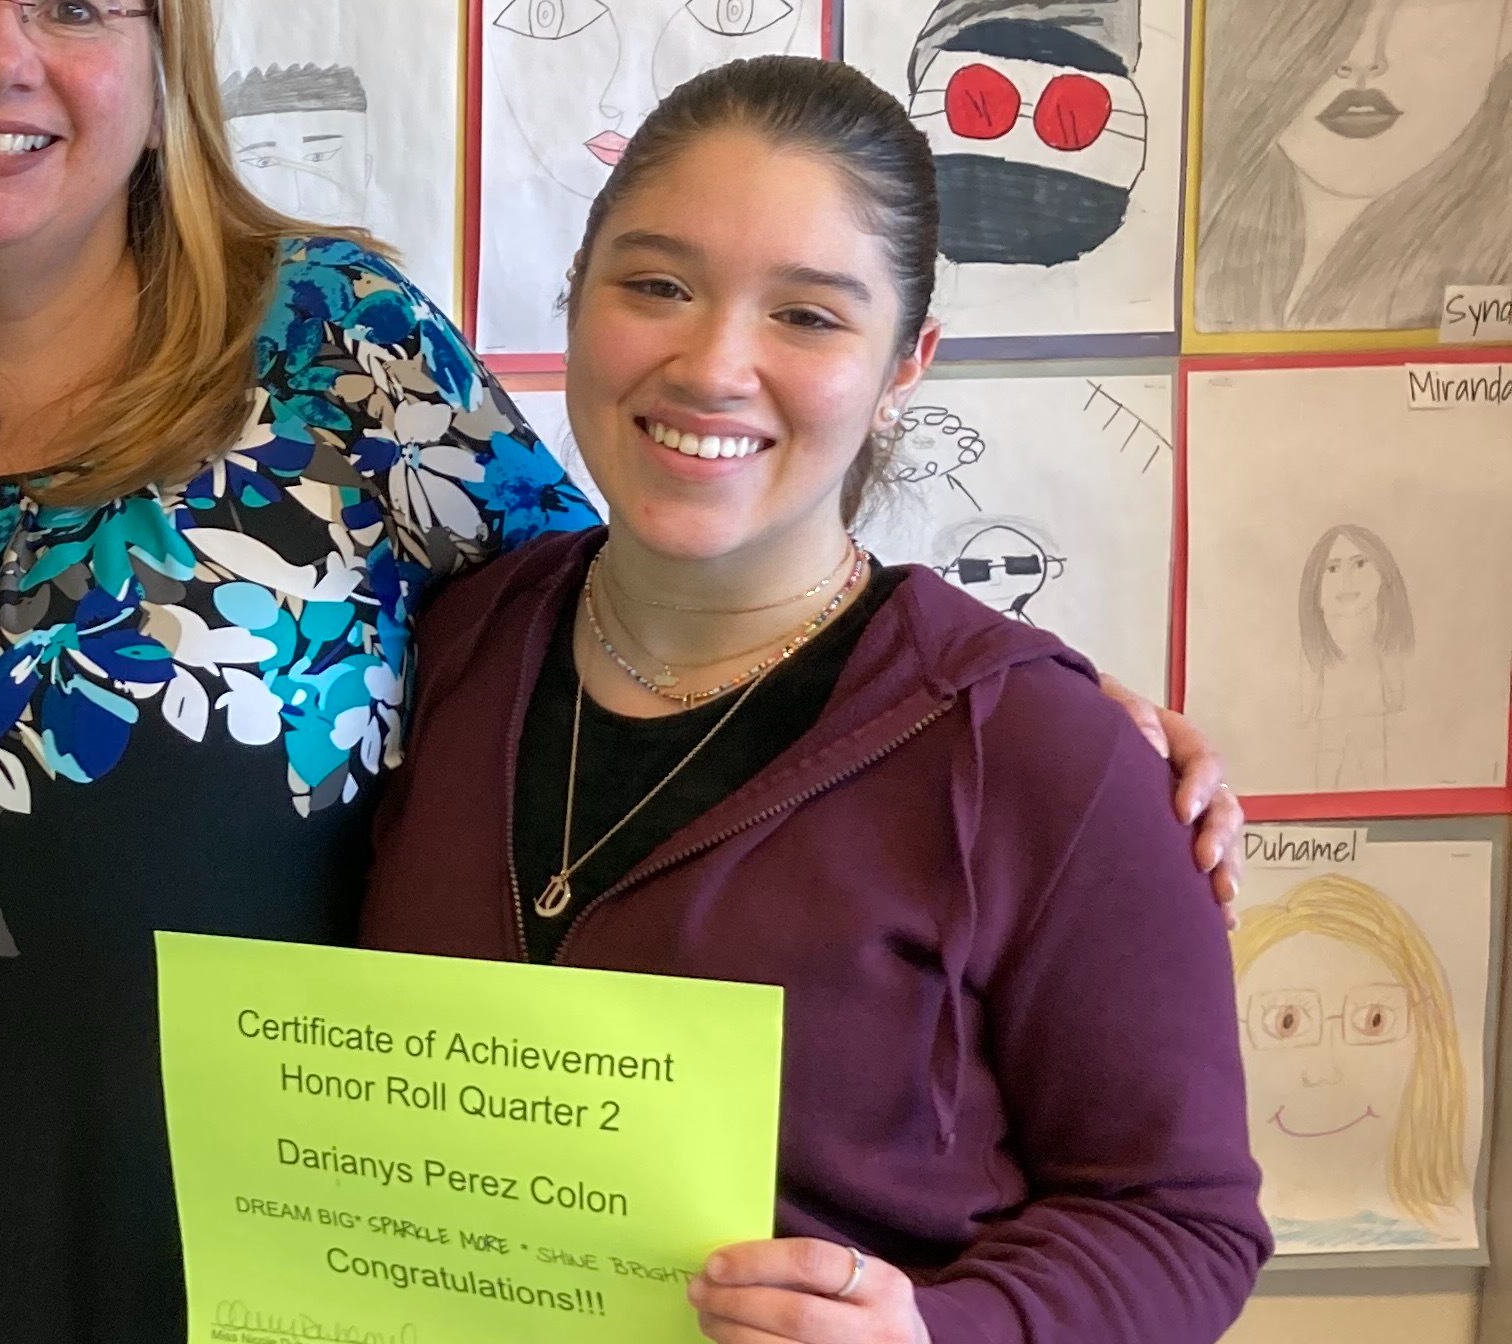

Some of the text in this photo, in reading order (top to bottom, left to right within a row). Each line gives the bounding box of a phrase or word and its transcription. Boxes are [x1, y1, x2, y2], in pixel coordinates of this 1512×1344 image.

[1409, 365, 1512, 404] Miranda
[1244, 830, 1357, 862] Duhamel
[237, 1009, 675, 1083] Certificate of Achievement
[280, 1063, 621, 1132] Honor Roll Quarter 2
[277, 1138, 628, 1217] Darianys Perez Colon
[236, 1196, 312, 1222] DREAM
[368, 1216, 450, 1244] SPARKLE
[459, 1230, 510, 1254] MORE
[537, 1247, 599, 1271] SHINE
[609, 1256, 698, 1283] BRIGHT
[326, 1248, 606, 1317] Congratulations!!!
[211, 1329, 238, 1343] Miss
